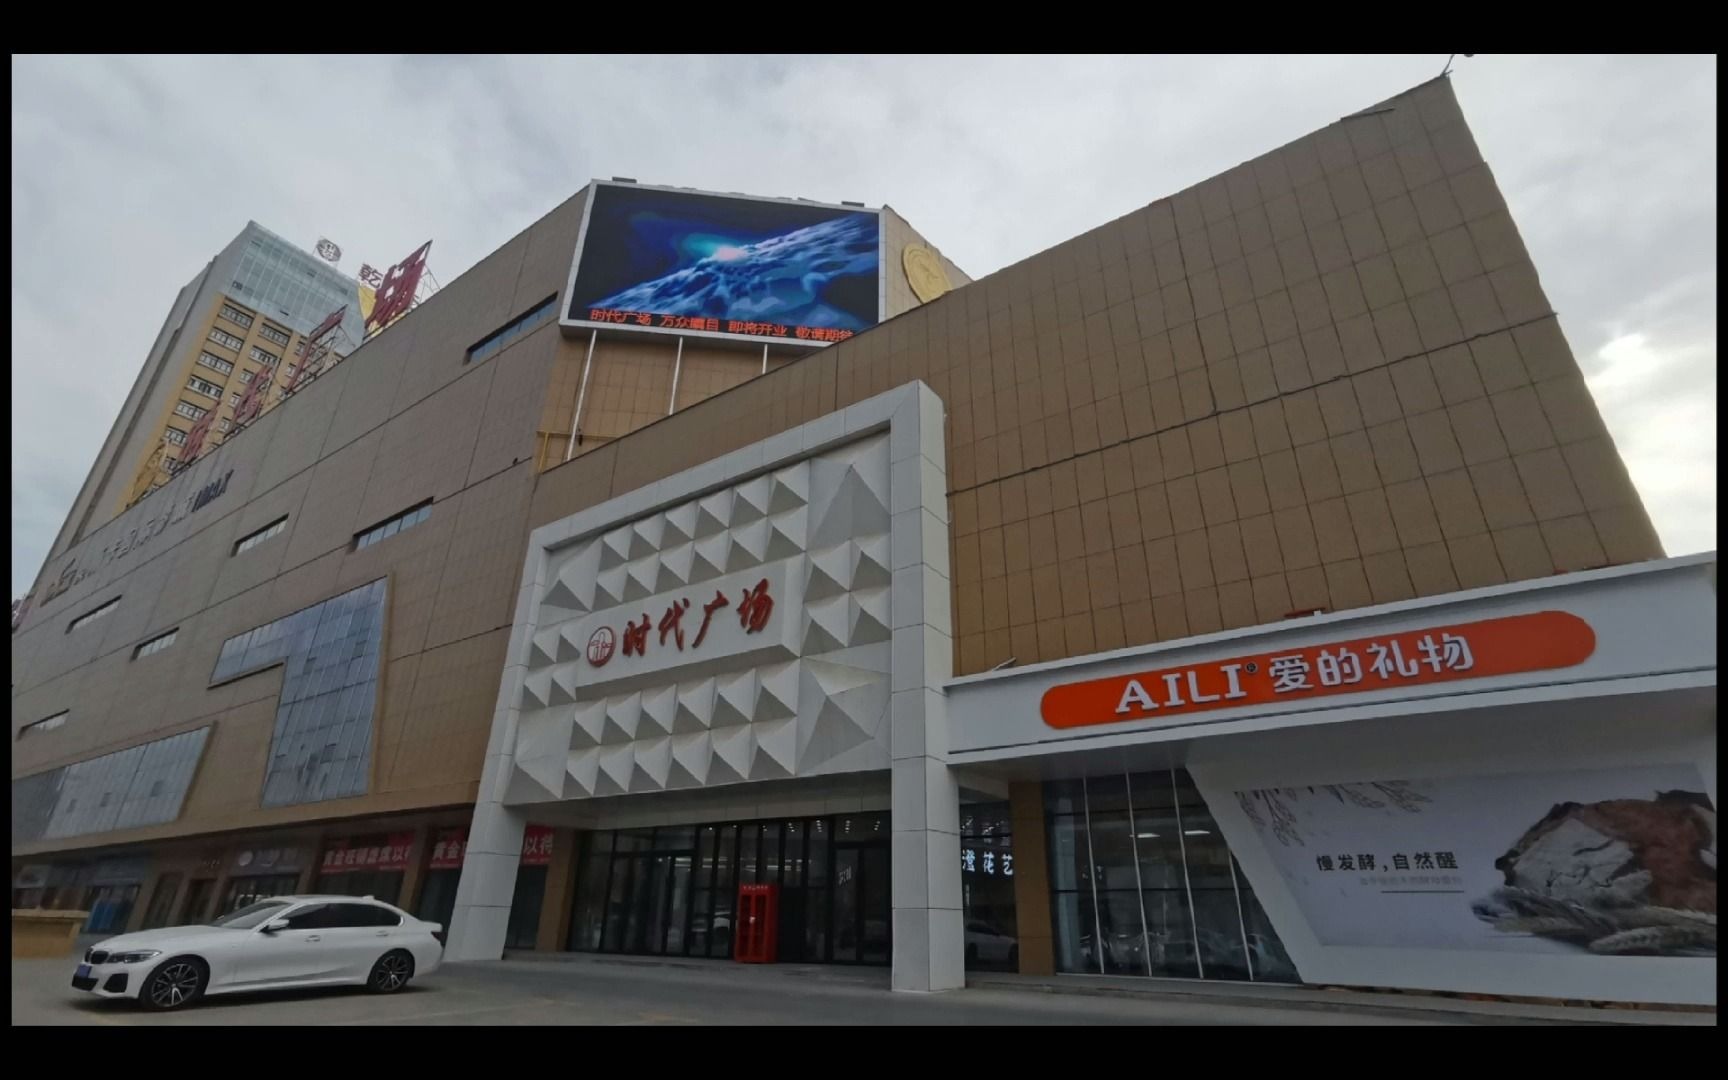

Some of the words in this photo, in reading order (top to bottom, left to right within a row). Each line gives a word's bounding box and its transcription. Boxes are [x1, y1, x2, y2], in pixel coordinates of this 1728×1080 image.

[590, 309, 652, 326] 时代广场
[727, 320, 789, 337] 即将开业
[622, 578, 775, 657] 时代广场
[1269, 632, 1474, 693] 爱的礼物
